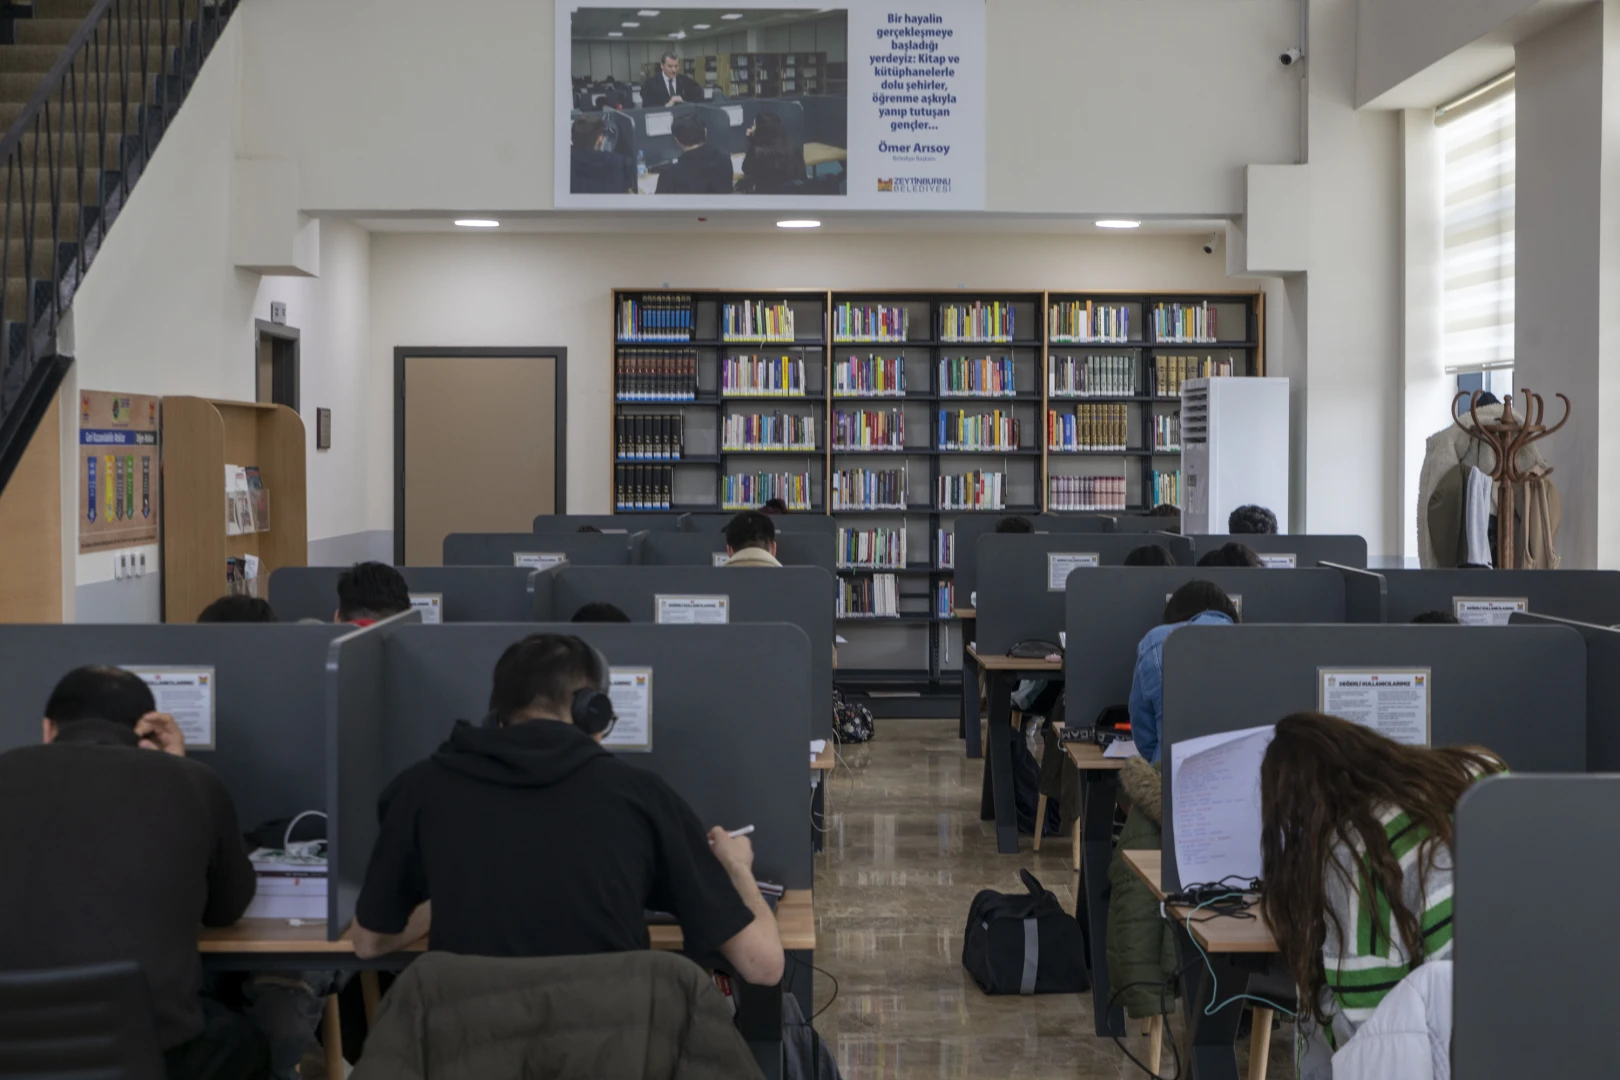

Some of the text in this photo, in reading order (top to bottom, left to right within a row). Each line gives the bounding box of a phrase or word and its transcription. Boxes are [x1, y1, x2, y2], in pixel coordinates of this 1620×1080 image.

[887, 13, 942, 25] Bir hayalin
[876, 27, 953, 38] gerçekleşmeye
[891, 40, 938, 51] başladığı
[869, 54, 960, 65] yerdeyiz: Kitap ve
[874, 67, 955, 79] kütüphanelerle
[880, 80, 948, 92] dolu şehirler,
[872, 94, 957, 105] öğrenme aşkıyla
[878, 107, 950, 119] yanıp tutuşan
[878, 140, 950, 155] Ömer Arısoy
[894, 177, 951, 185] ZEYTİNBURNU
